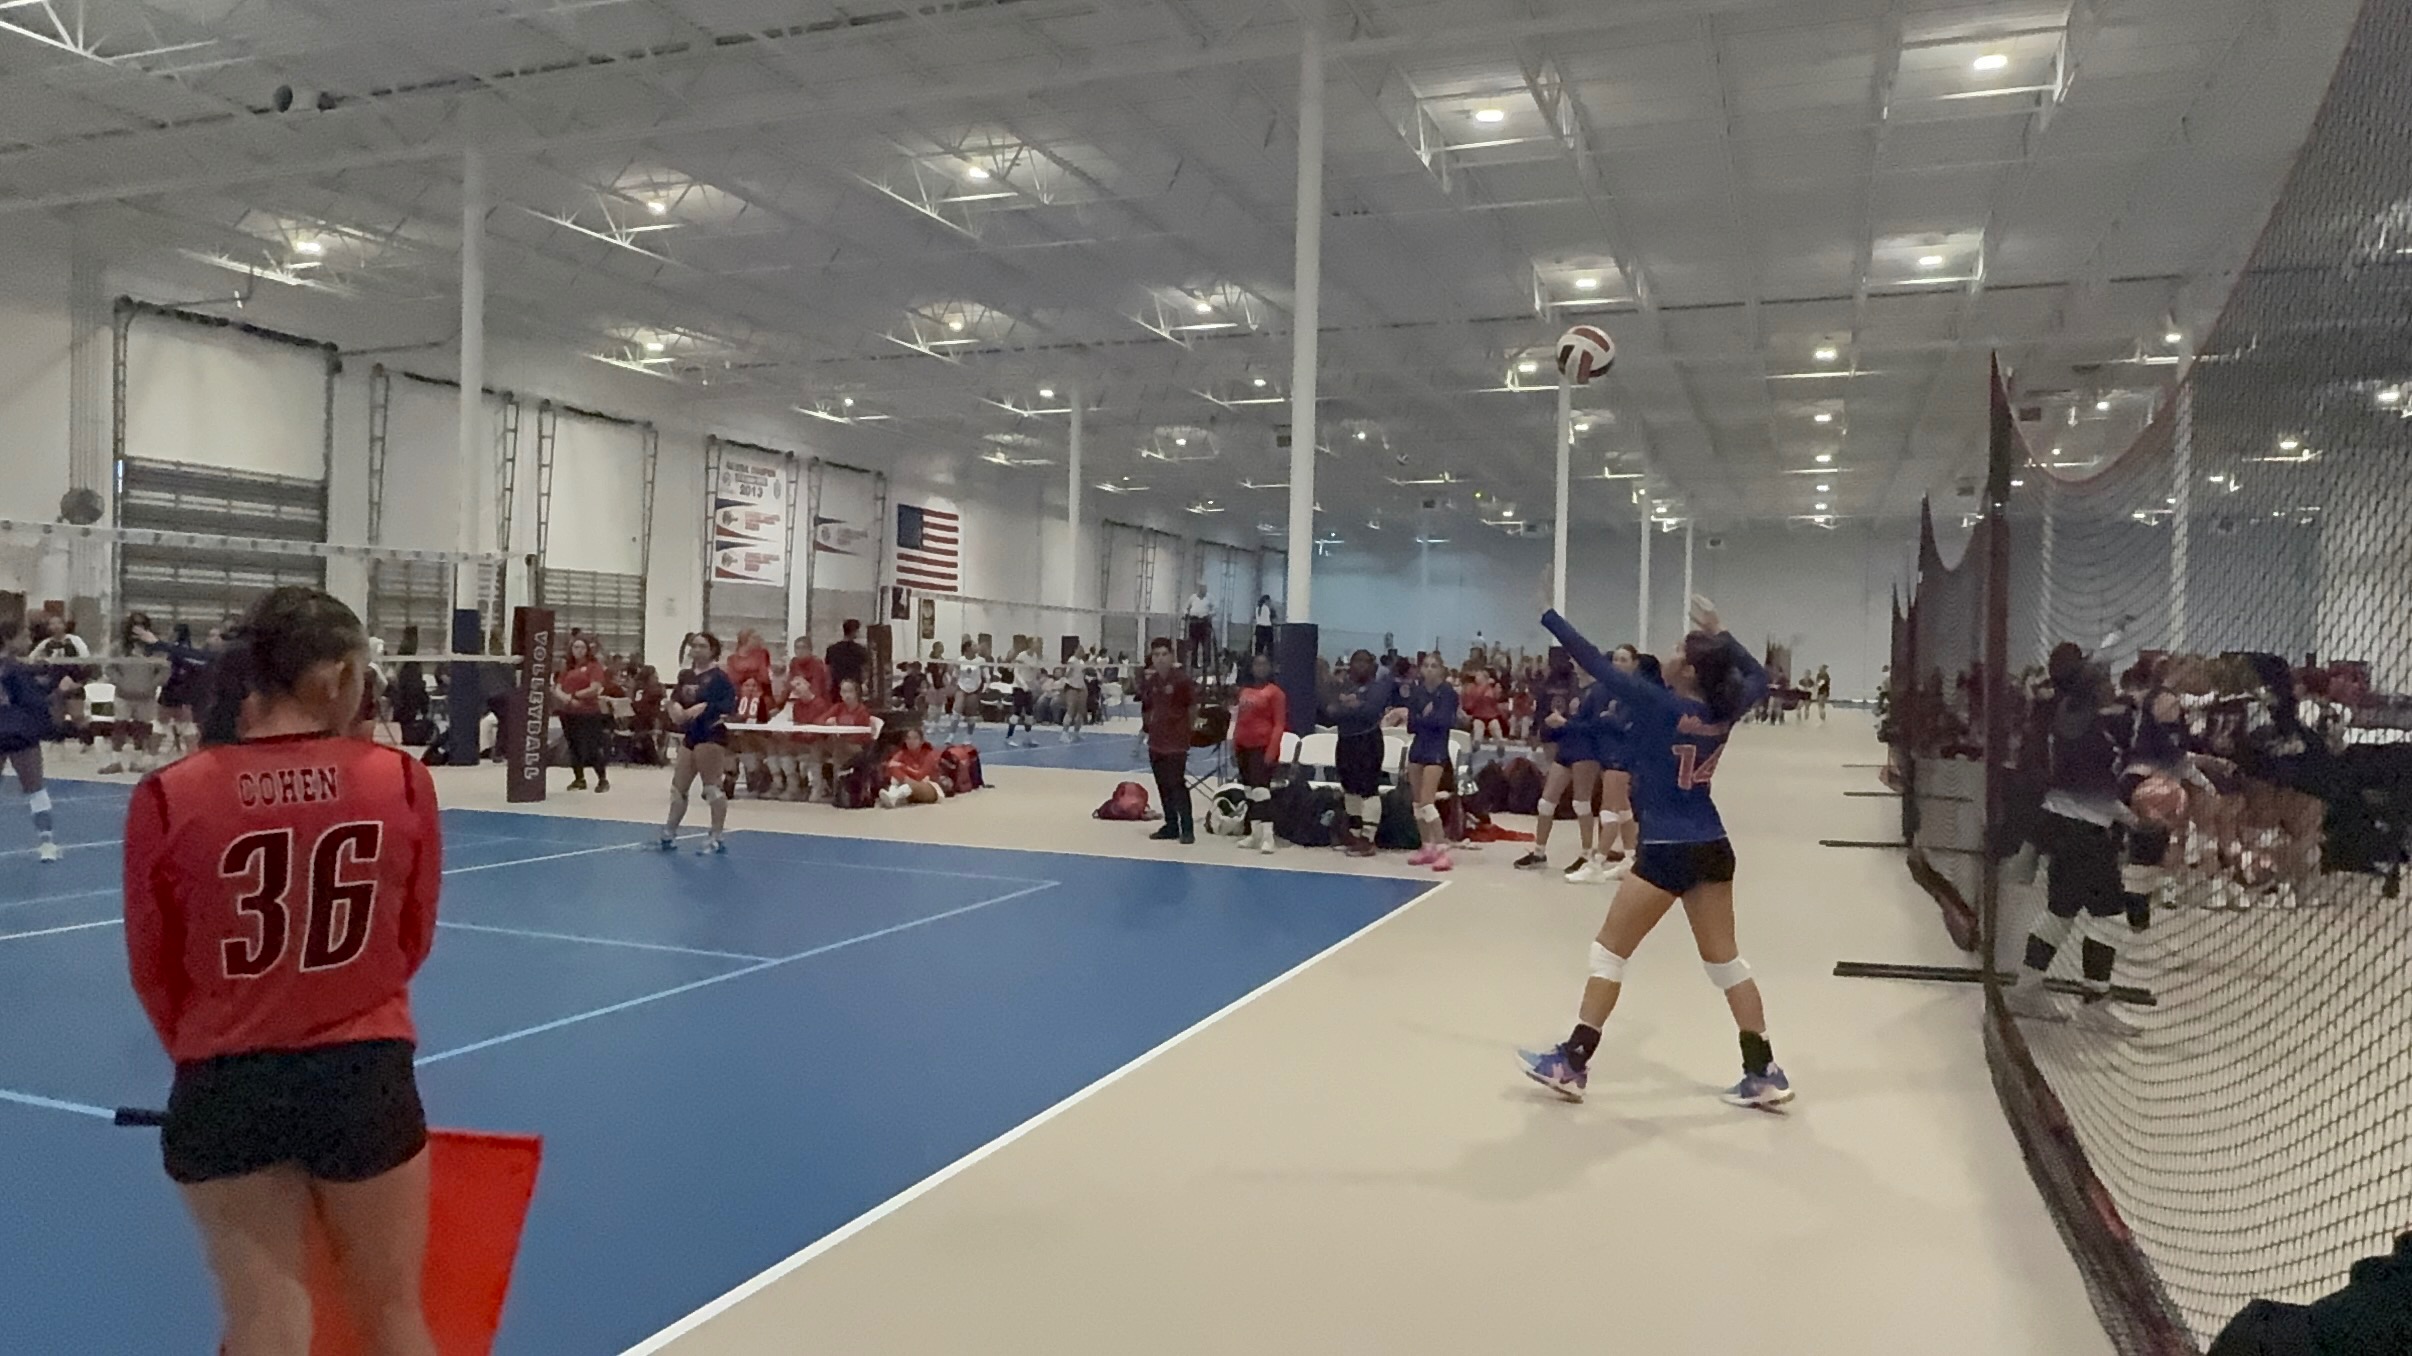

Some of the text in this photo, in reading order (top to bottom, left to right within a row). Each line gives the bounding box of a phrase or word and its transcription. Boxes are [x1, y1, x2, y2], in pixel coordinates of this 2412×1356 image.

[740, 484, 763, 498] 2013
[524, 630, 548, 780] VOLLEYBALL
[239, 766, 338, 807] COHEN
[219, 820, 383, 978] 36
